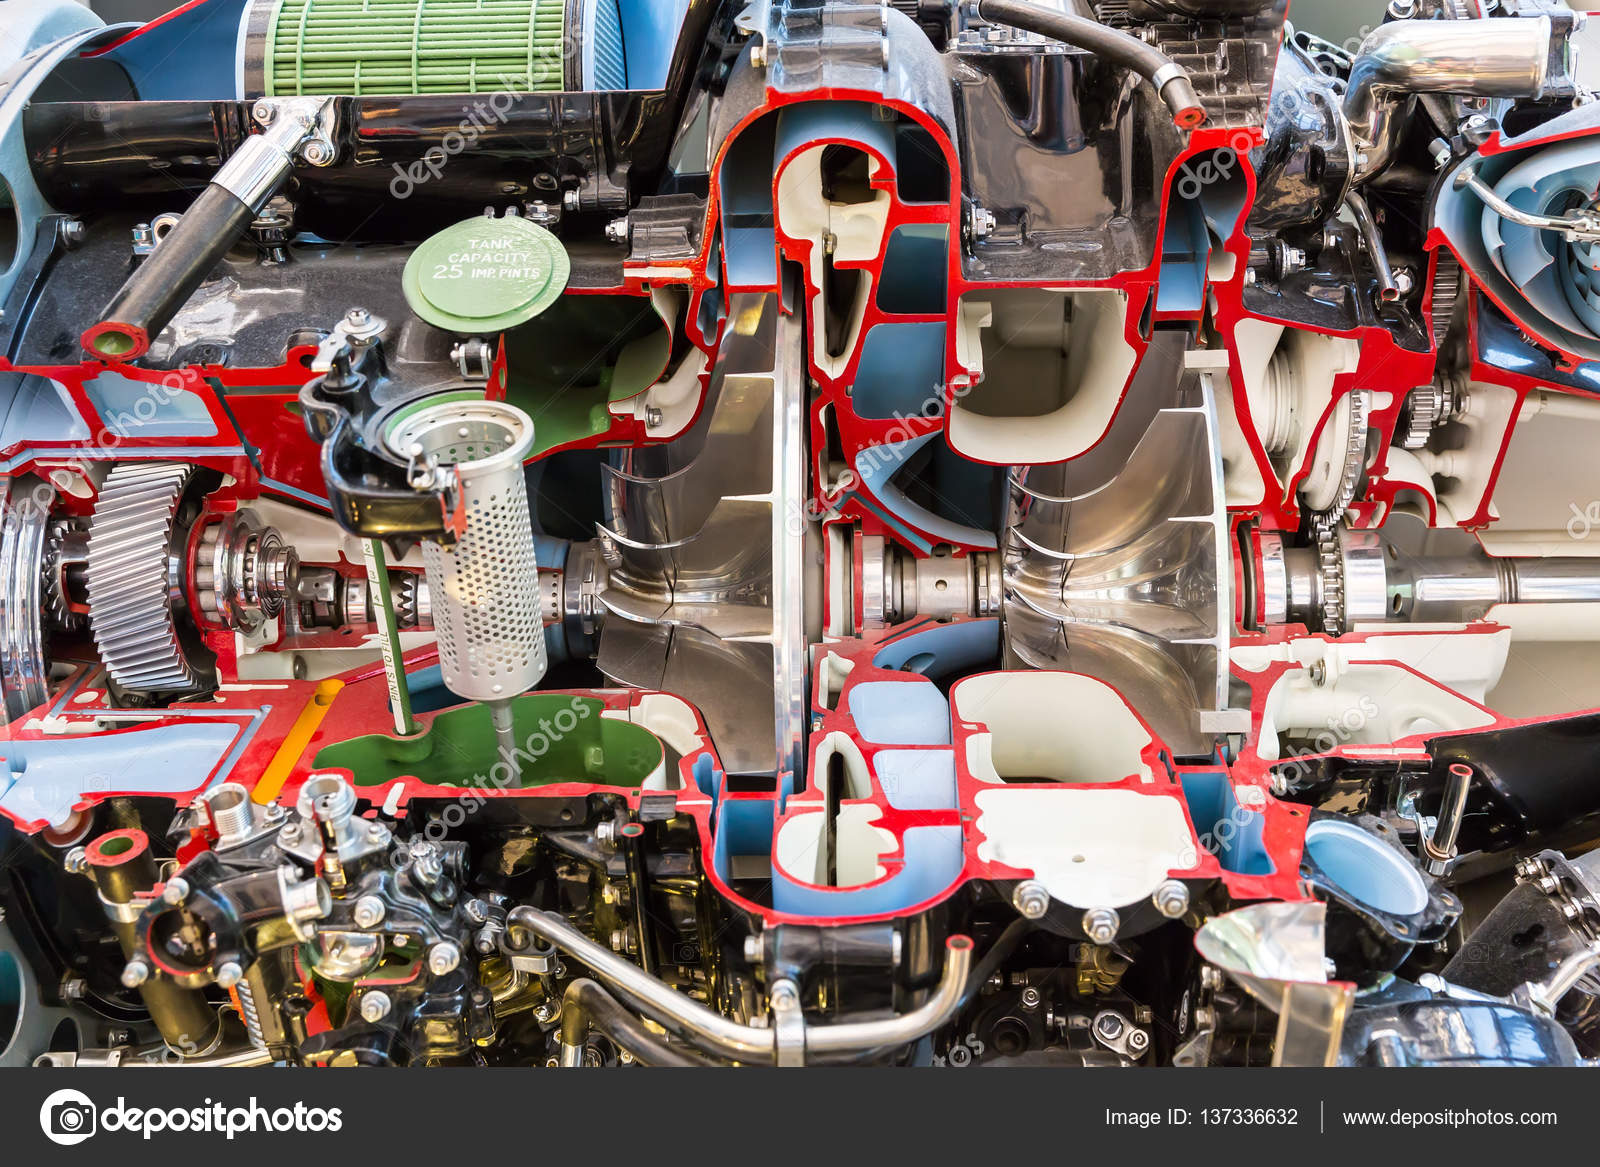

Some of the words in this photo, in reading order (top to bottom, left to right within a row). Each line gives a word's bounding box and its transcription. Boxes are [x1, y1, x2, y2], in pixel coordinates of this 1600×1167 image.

[468, 239, 514, 249] TANK
[448, 252, 531, 263] CAPACITY
[432, 264, 463, 279] 25
[499, 267, 541, 280] PINTS
[380, 631, 391, 652] FILL
[384, 655, 393, 668] TO
[387, 671, 400, 702] PINTS
